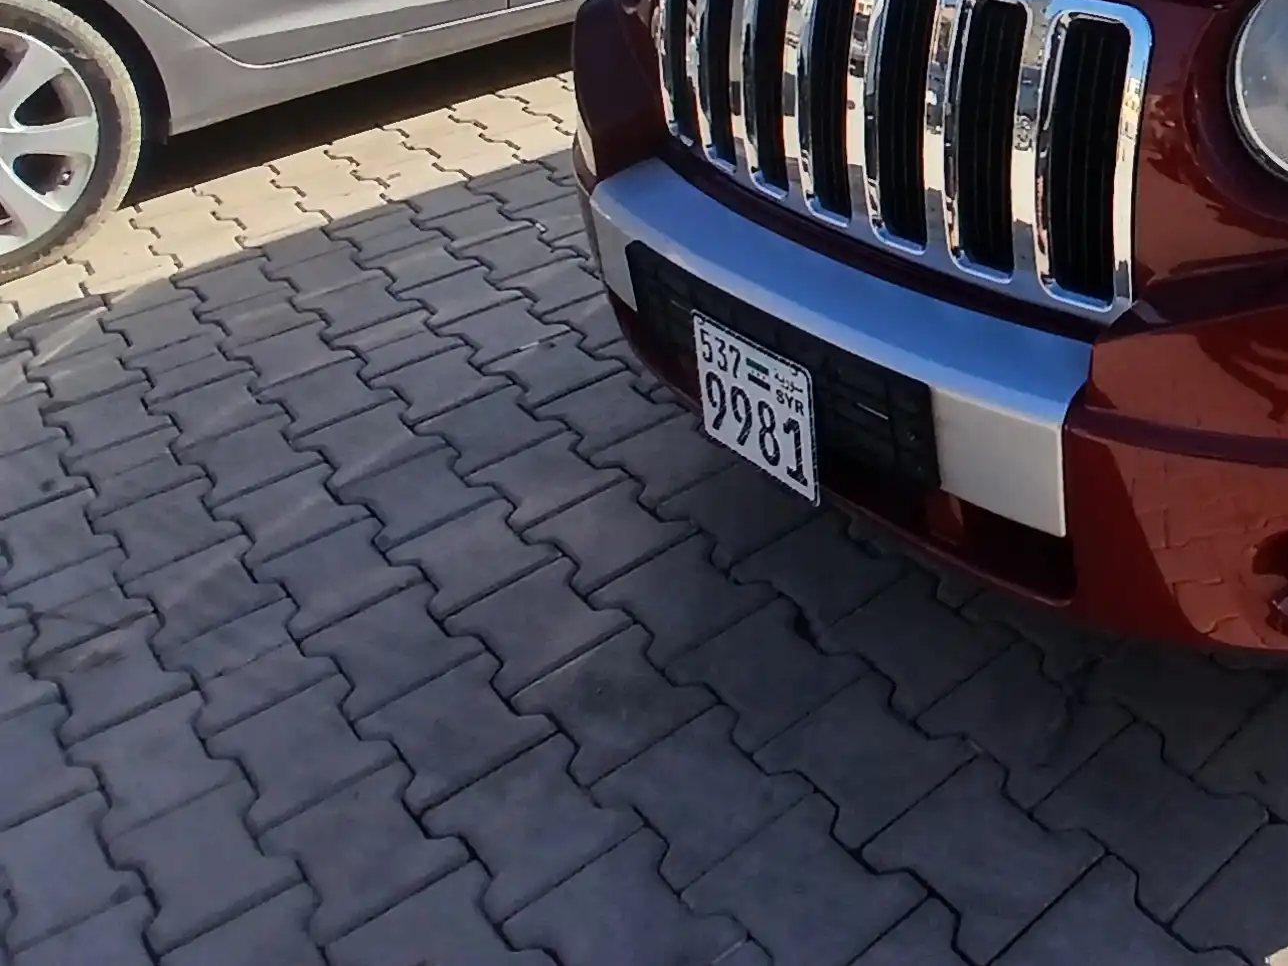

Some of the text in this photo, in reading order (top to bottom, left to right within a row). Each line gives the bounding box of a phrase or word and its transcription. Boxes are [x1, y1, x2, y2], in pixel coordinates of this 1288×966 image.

[700, 329, 741, 378] 537
[775, 390, 804, 416] SYR
[706, 371, 808, 486] 9981
